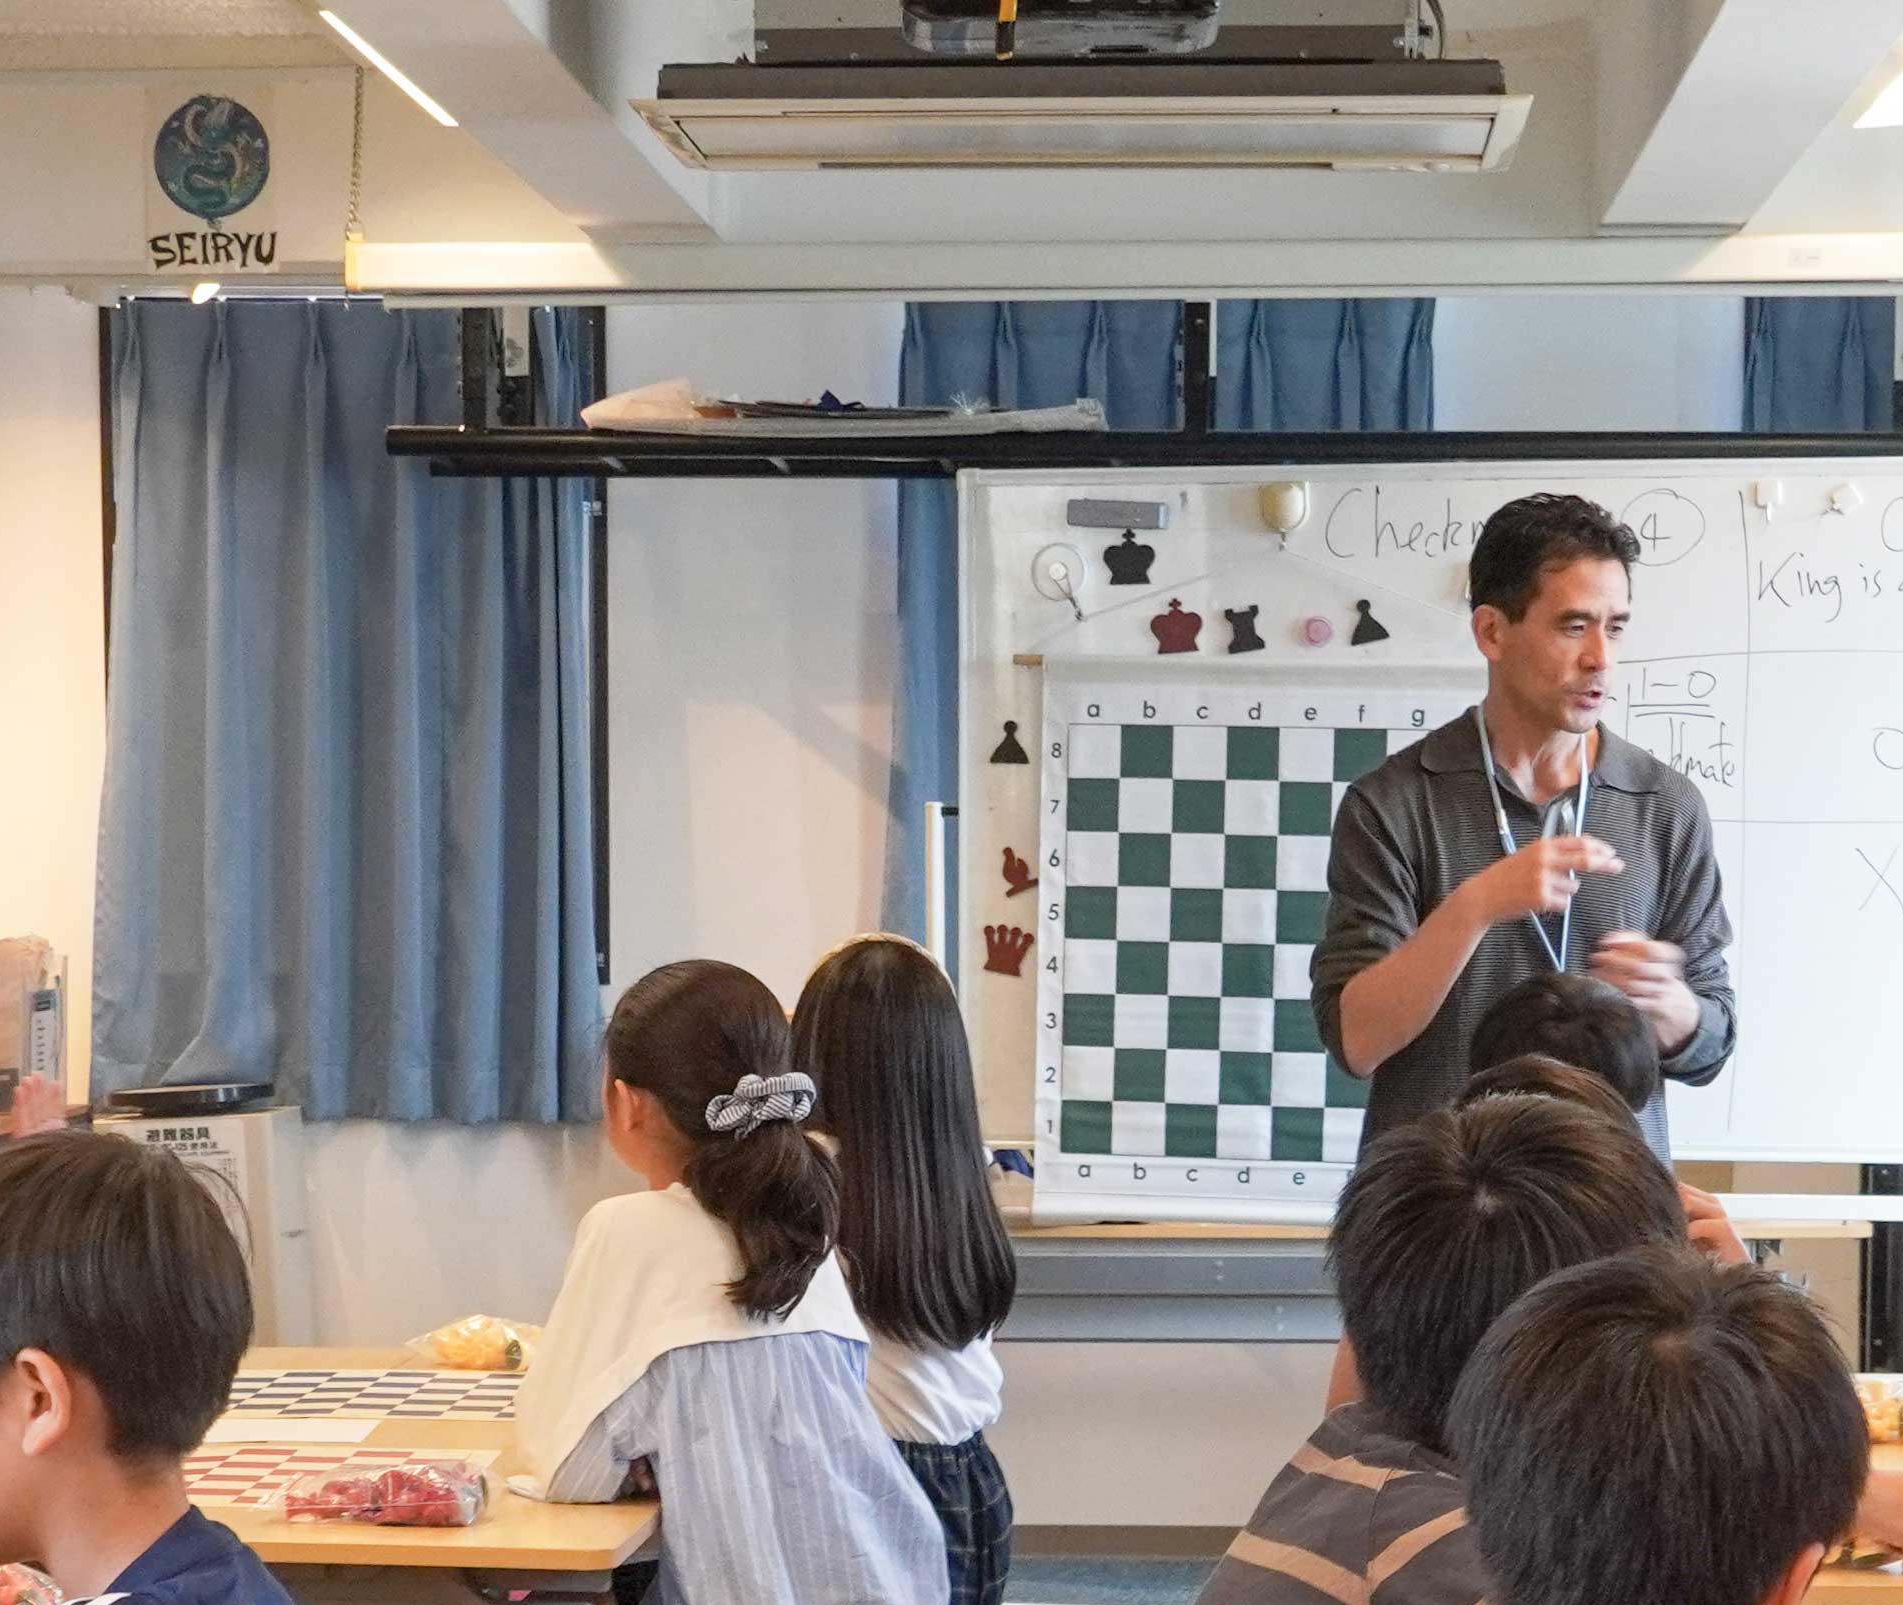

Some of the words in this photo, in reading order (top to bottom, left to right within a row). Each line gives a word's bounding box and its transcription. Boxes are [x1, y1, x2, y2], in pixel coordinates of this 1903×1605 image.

[147, 231, 277, 269] SEIRYU
[1758, 551, 1843, 623] King
[1859, 563, 1883, 598] is
[1087, 703, 1100, 718] a
[1143, 700, 1157, 719] b
[1196, 705, 1209, 720] c
[1248, 702, 1262, 720] d
[1304, 707, 1318, 721] e
[1357, 703, 1366, 723] f
[1411, 708, 1425, 728] g
[1050, 742, 1062, 760] 8
[1049, 798, 1060, 815] 7
[1048, 848, 1061, 868] 6
[1047, 902, 1060, 921] 5
[1045, 955, 1059, 974] 4
[1045, 1012, 1057, 1030] 3
[1044, 1066, 1057, 1084] 2
[1046, 1119, 1053, 1135] 1
[1077, 1164, 1092, 1178] a
[1133, 1162, 1147, 1180] b
[1186, 1168, 1199, 1182] c
[1237, 1166, 1251, 1184] d
[1292, 1171, 1306, 1186] e
